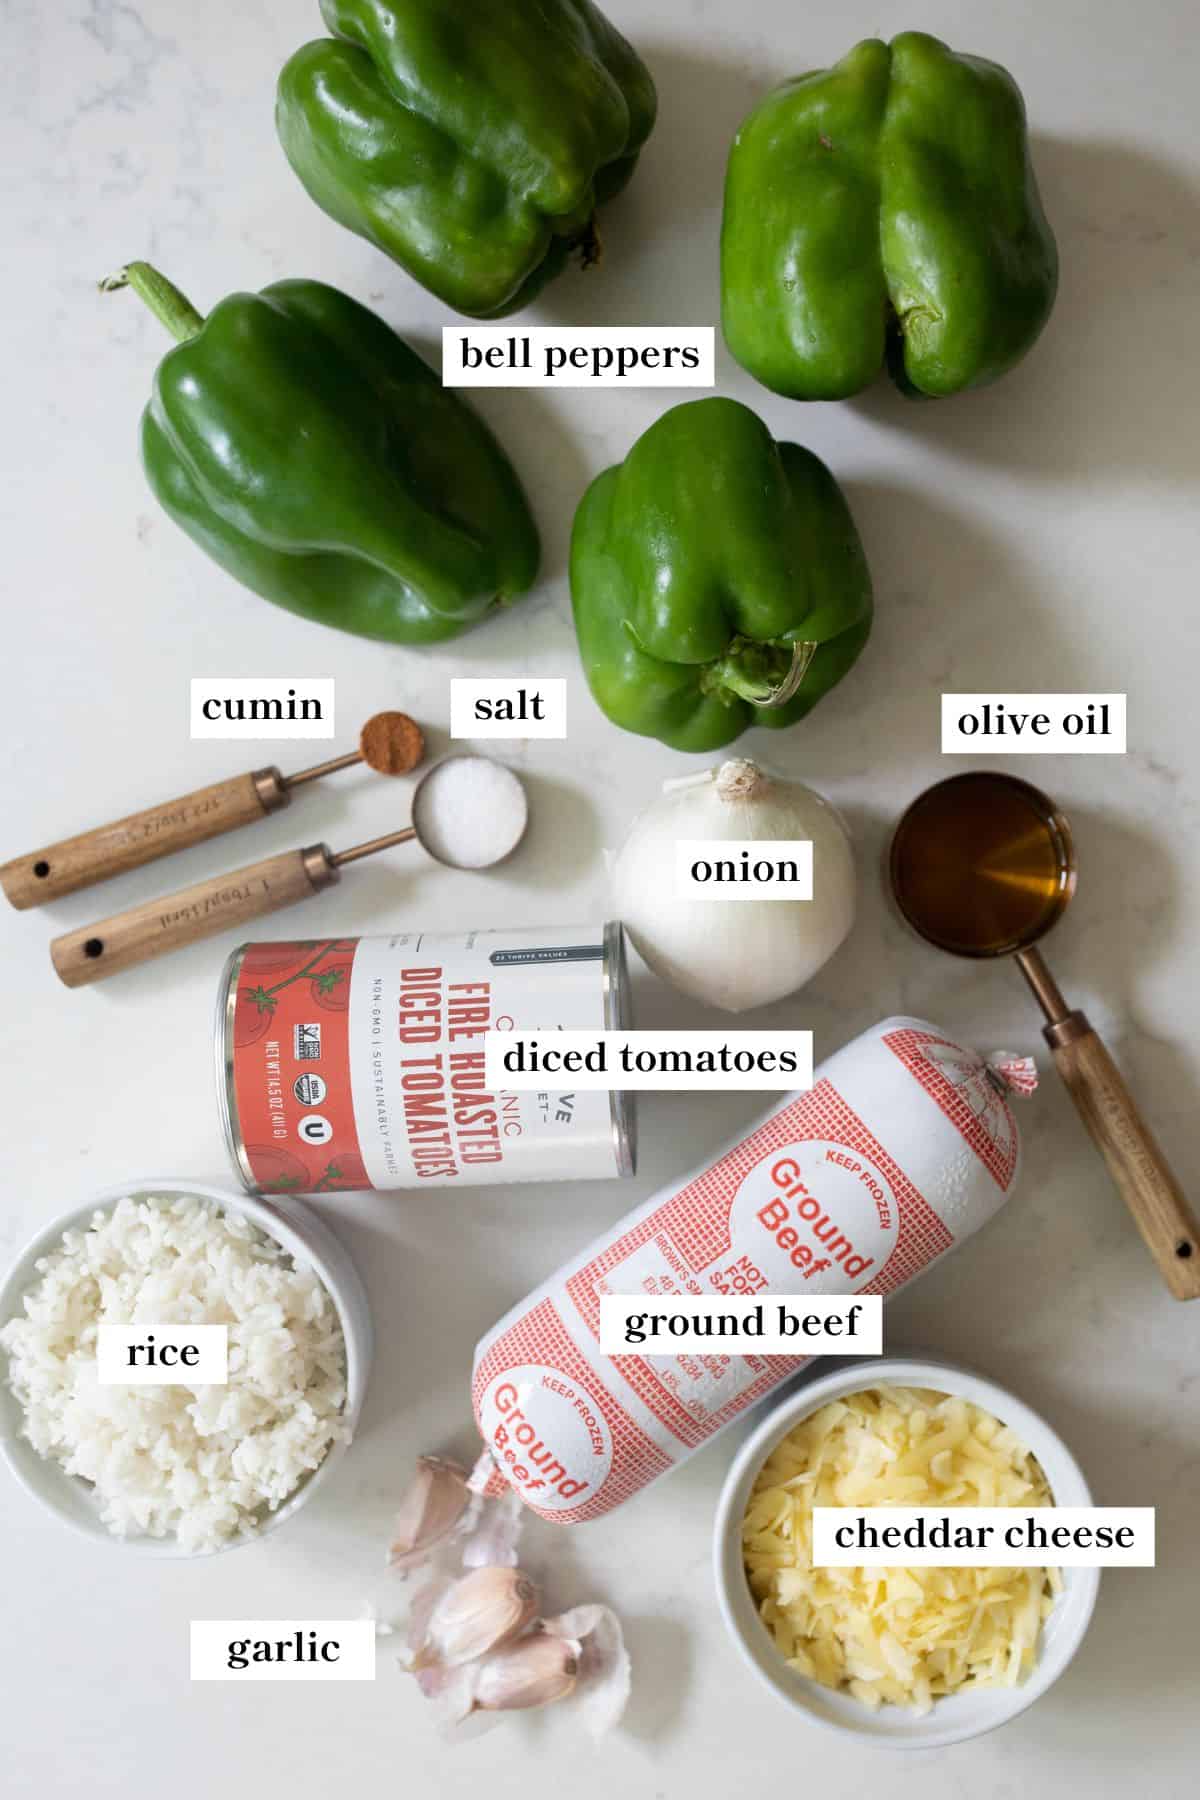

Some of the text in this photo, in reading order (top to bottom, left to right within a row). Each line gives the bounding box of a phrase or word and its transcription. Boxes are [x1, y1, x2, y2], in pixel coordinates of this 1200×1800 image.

[538, 951, 568, 960] VALUES
[371, 978, 382, 1035] NON-GMO
[264, 1040, 280, 1057] NET
[266, 1060, 281, 1076] WT
[399, 967, 459, 1178] DICED TOMATOES
[447, 982, 503, 1165] FIRE ROASTED
[267, 1077, 282, 1096] 14.5
[269, 1097, 283, 1110] OZ
[311, 1079, 320, 1099] USDA
[373, 1049, 390, 1138] SUSTAINABLY
[770, 1158, 875, 1280] Ground
[825, 1150, 891, 1230] KEEP FROZEN
[756, 1196, 832, 1280] Beef
[736, 1255, 768, 1290] NOT
[494, 1383, 589, 1499] Ground
[542, 1376, 604, 1456] KEEP FROZEN
[494, 1424, 546, 1489] Beef
